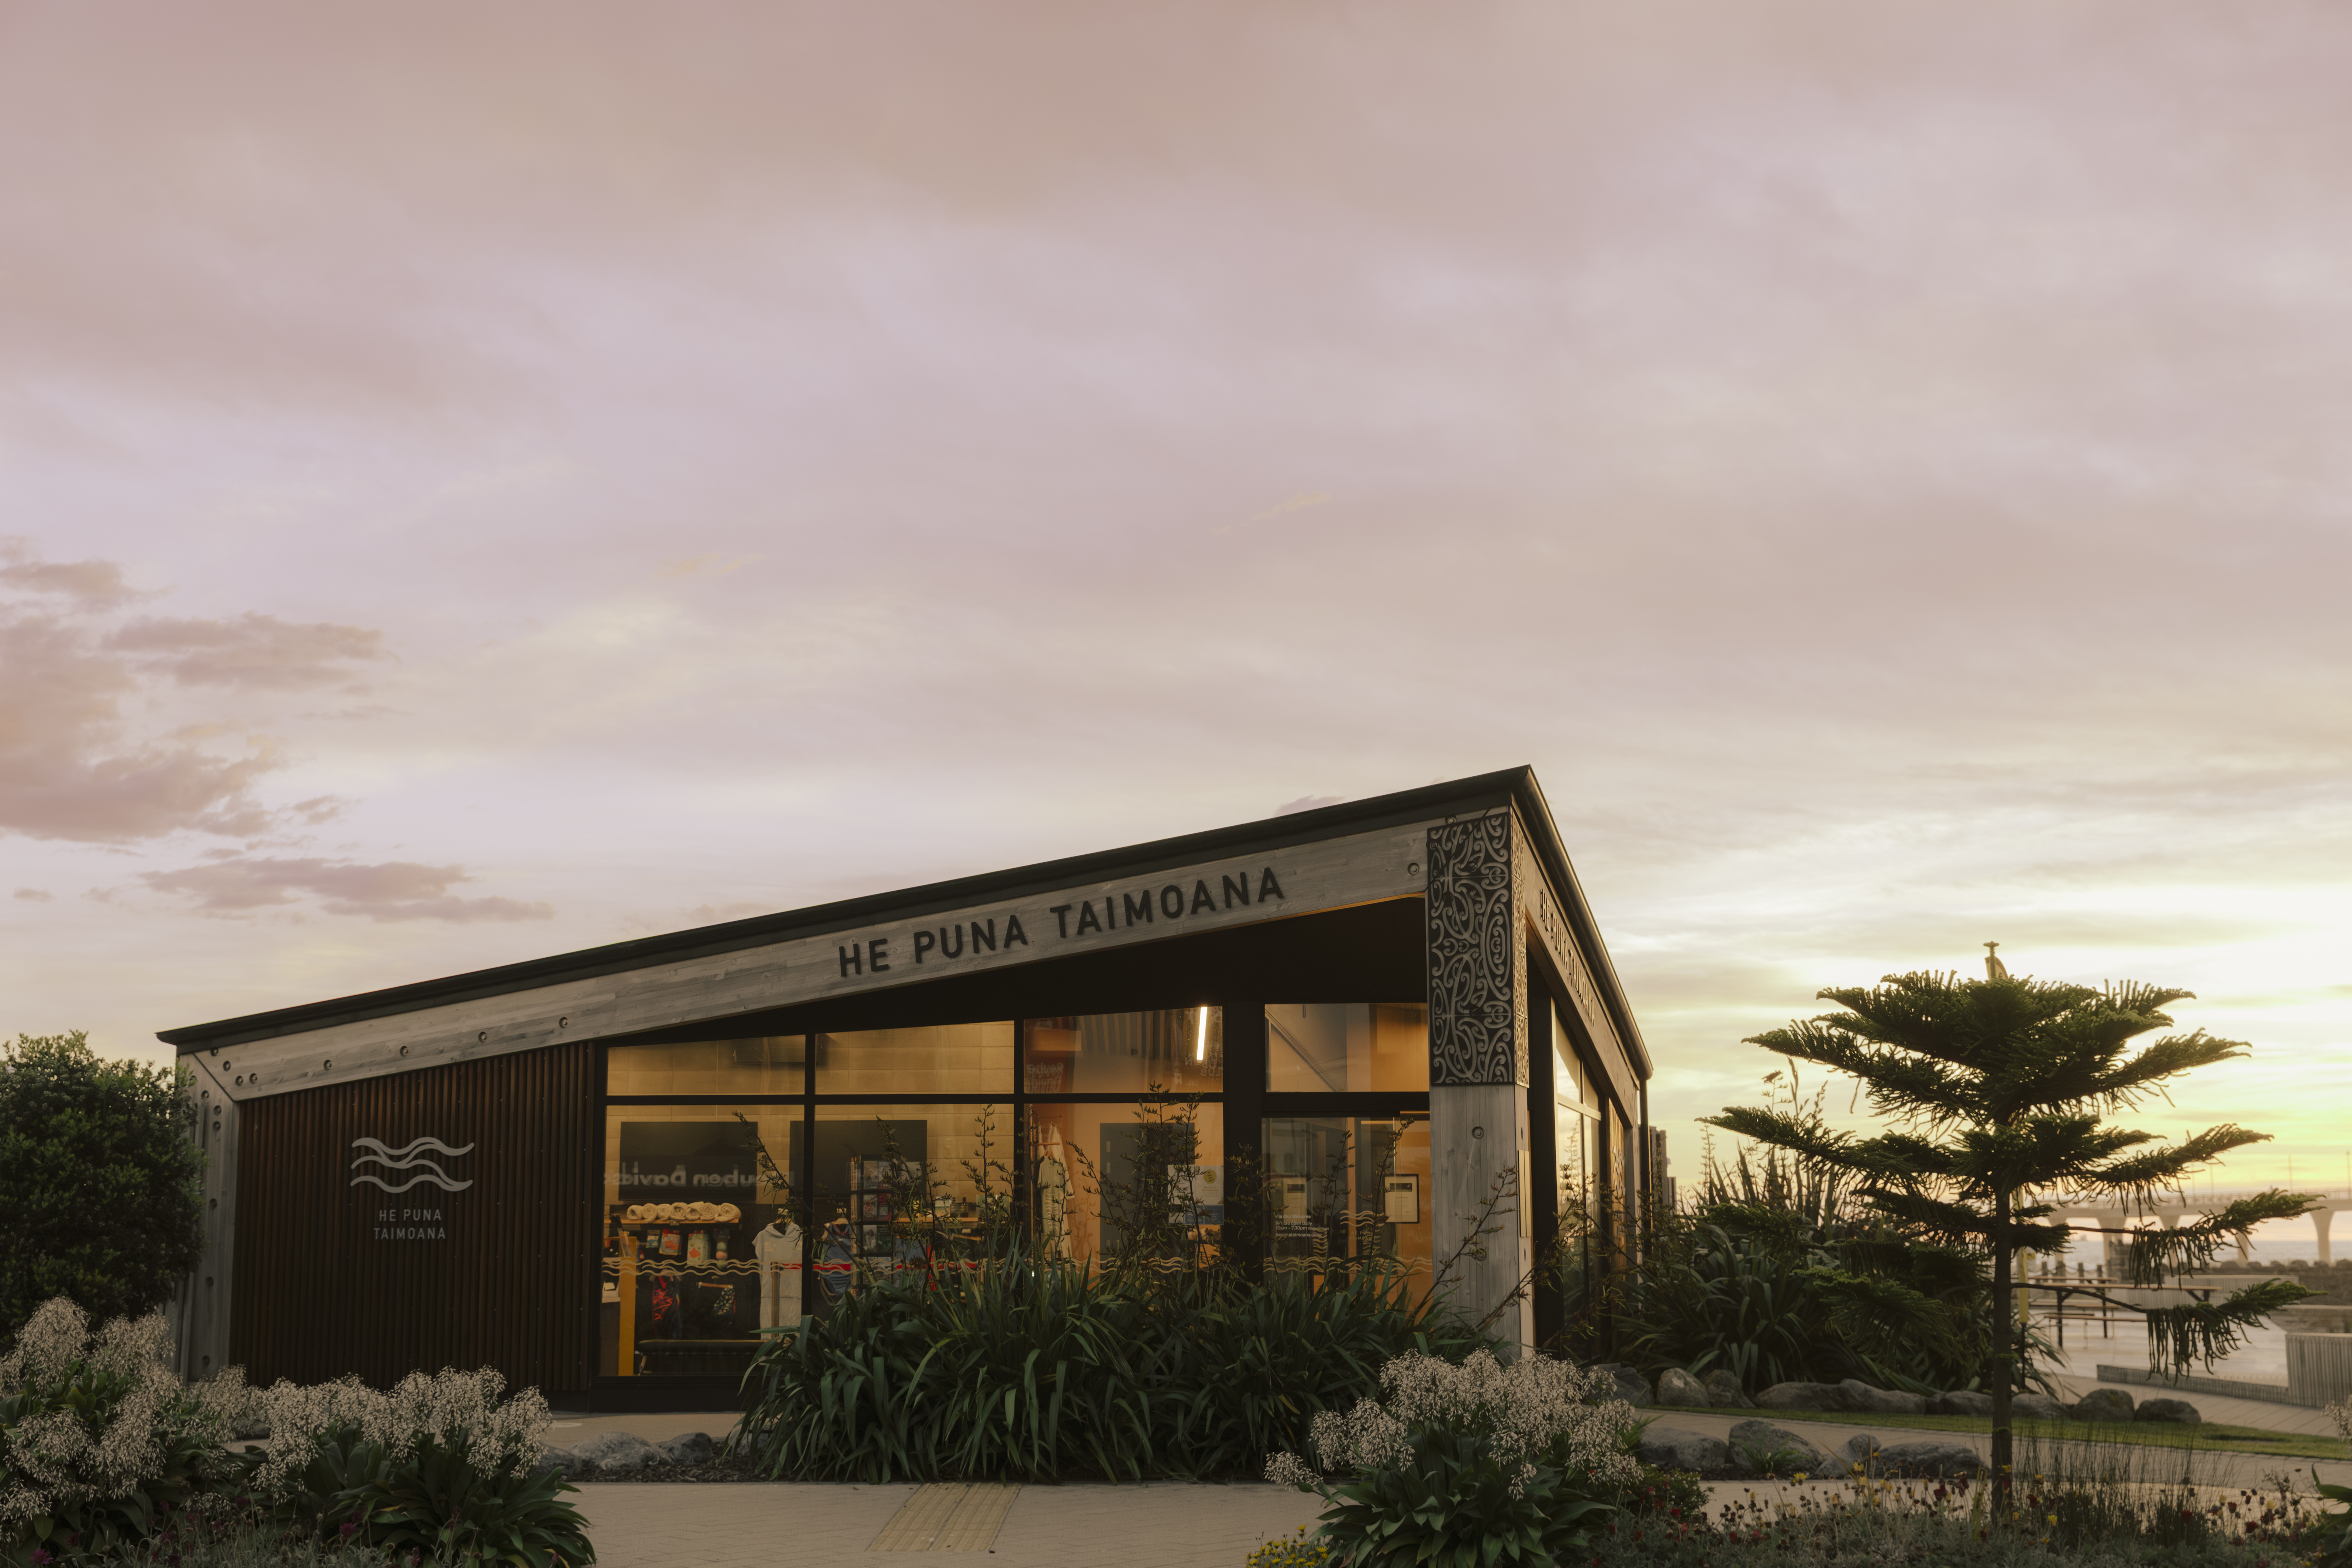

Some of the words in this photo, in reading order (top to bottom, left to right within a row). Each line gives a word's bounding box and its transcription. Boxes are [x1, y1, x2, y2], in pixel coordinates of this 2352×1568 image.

[839, 937, 889, 978] HE
[913, 914, 1028, 964] PUNA
[1049, 867, 1285, 939] TAIMOANA
[1540, 888, 1550, 933] HE
[1551, 911, 1568, 970] PUNA
[1568, 948, 1595, 1027] TAIMOANA
[373, 1227, 446, 1240] TAIMOANA
[379, 1209, 396, 1222] HE
[403, 1209, 442, 1221] PUNA
